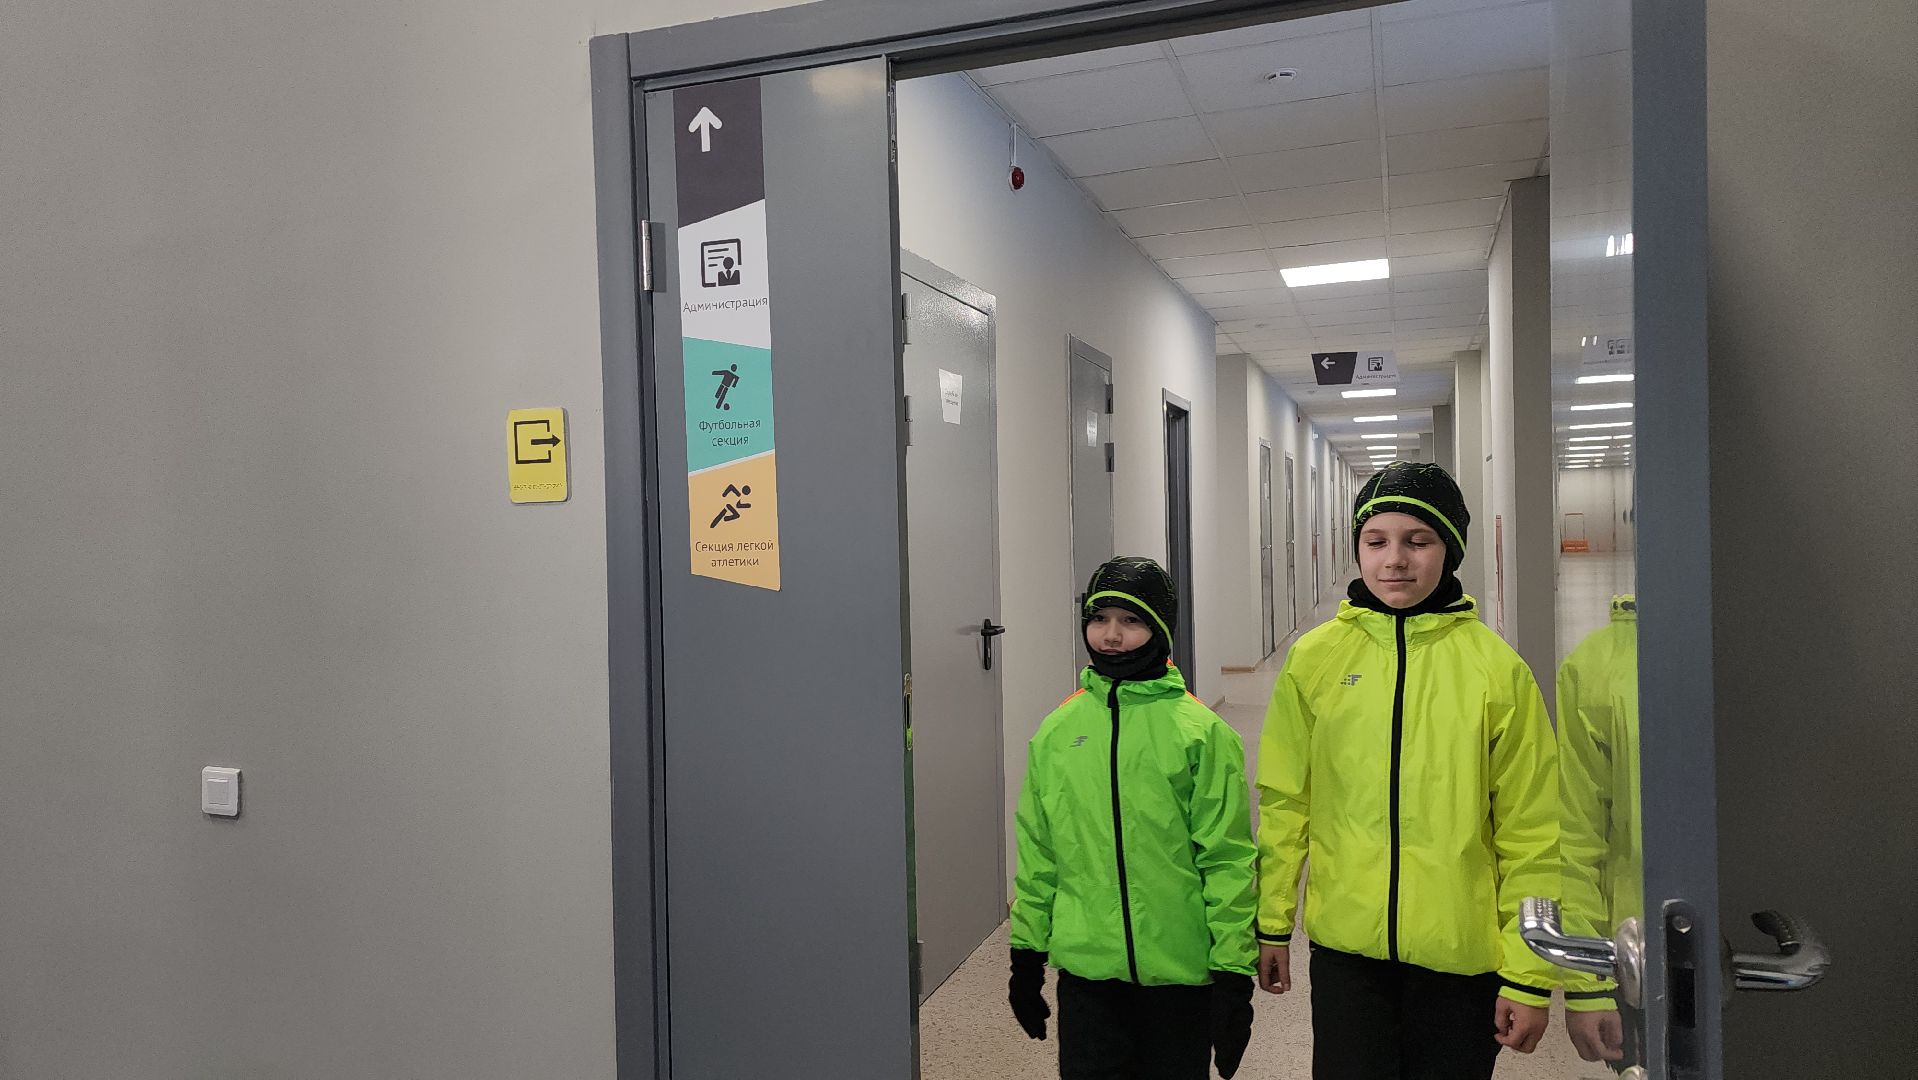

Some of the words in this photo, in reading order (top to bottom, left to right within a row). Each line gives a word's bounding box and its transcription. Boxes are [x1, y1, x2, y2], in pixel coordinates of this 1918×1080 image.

[683, 298, 768, 313] Администрация
[698, 419, 761, 433] Футбольная
[711, 436, 749, 447] секция
[695, 541, 734, 553] Секция
[736, 540, 774, 552] легкой
[711, 558, 760, 567] атлетики
